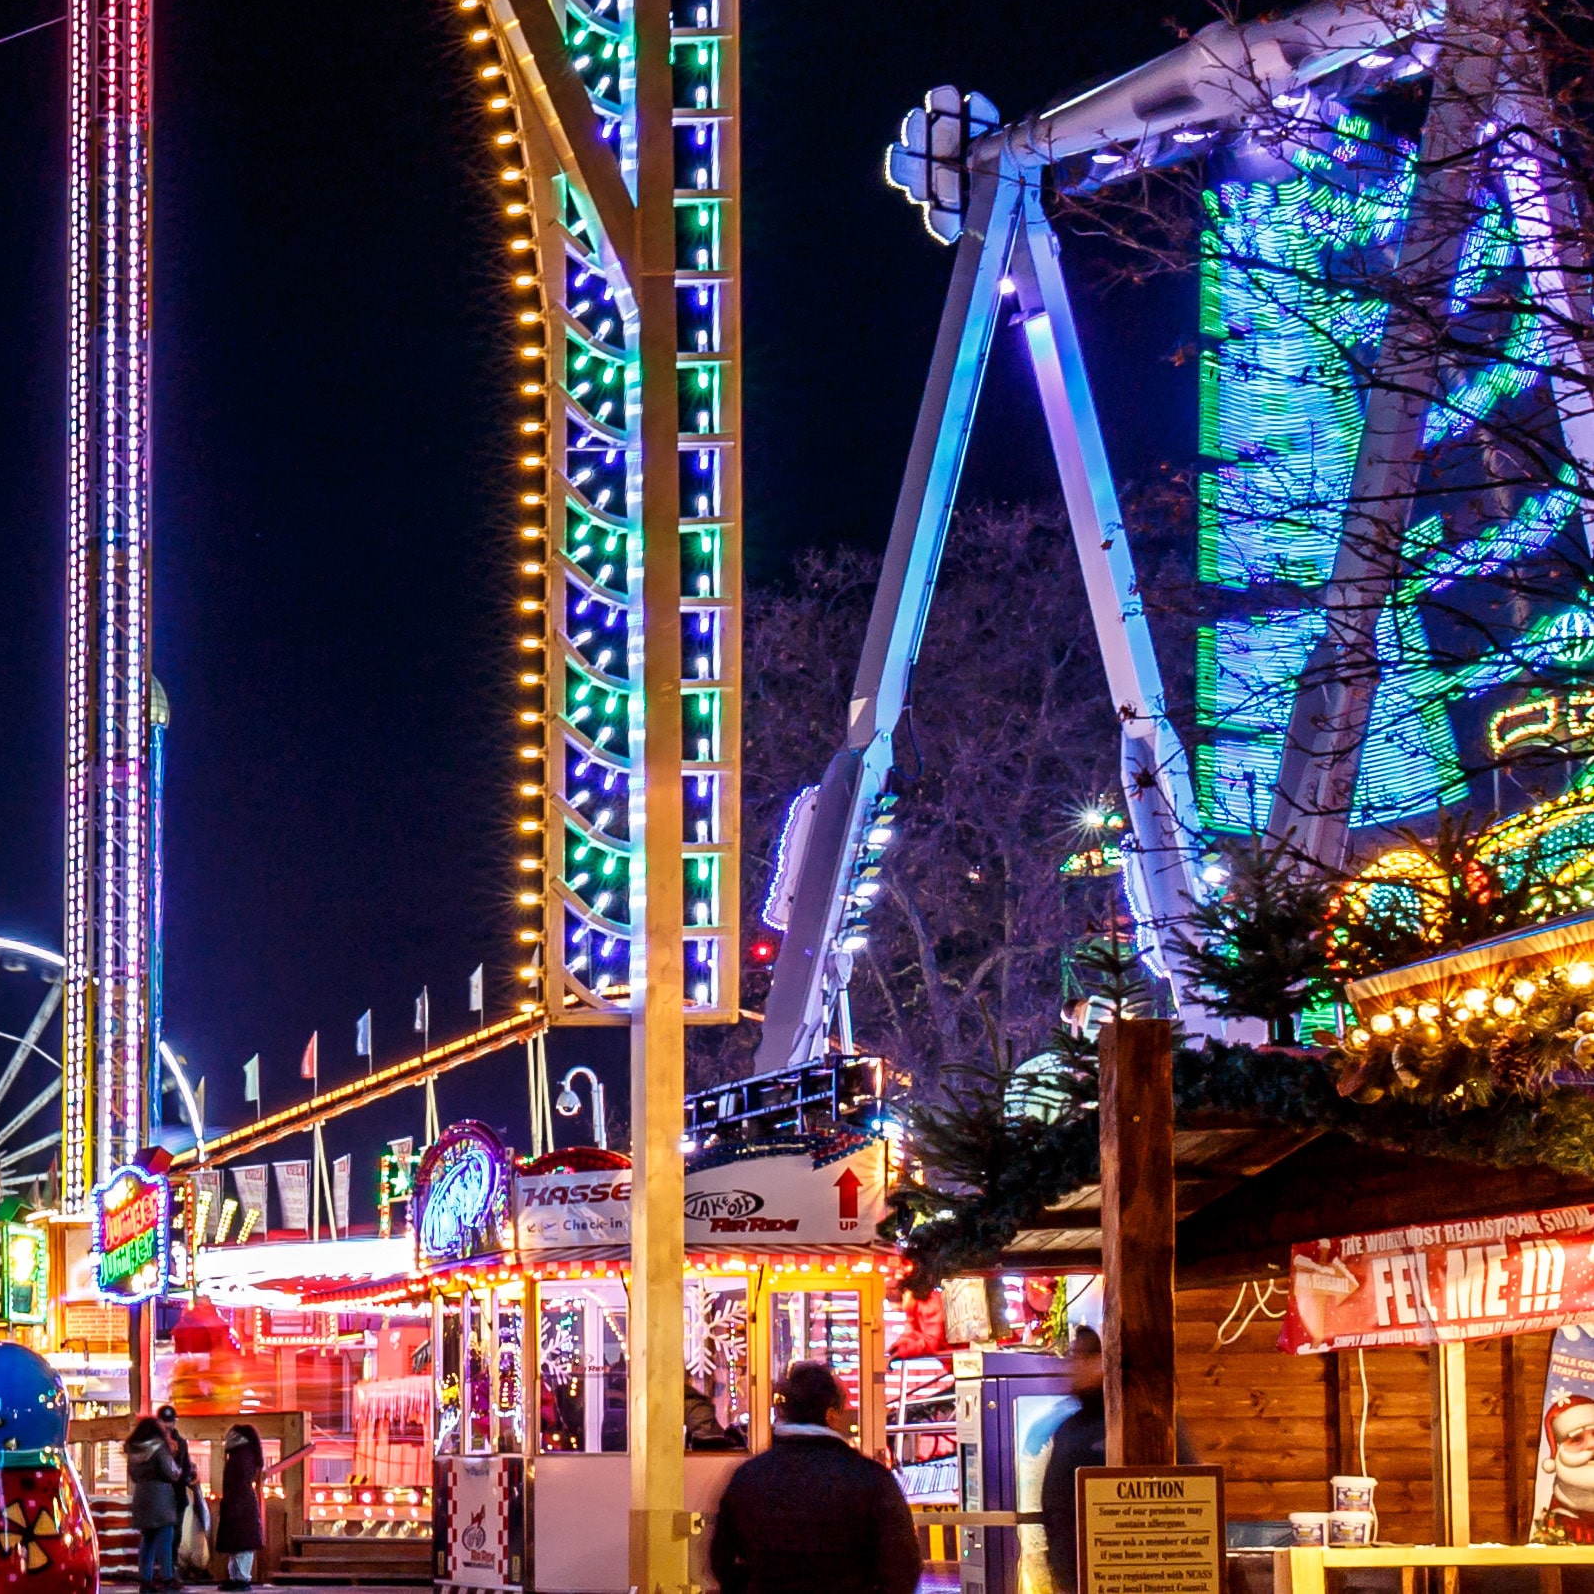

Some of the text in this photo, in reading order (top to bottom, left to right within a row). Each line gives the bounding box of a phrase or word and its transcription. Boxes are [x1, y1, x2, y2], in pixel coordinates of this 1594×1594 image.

[522, 1181, 632, 1207] KASSE
[690, 1194, 730, 1218] TAKE
[563, 1218, 623, 1233] Check-in
[839, 1221, 858, 1231] UP
[1340, 1236, 1364, 1256] THE
[1446, 1243, 1507, 1320] ME
[1518, 1239, 1566, 1313] !!!
[1116, 1481, 1184, 1499] CAUTION
[1098, 1507, 1121, 1516] Some
[1122, 1506, 1132, 1515] of
[1148, 1506, 1185, 1517] products
[1187, 1508, 1203, 1517] may
[1094, 1538, 1120, 1547] Please
[1123, 1537, 1136, 1546] ask
[1146, 1537, 1178, 1546] member
[1180, 1536, 1189, 1545] of
[1191, 1535, 1210, 1545] staff
[1100, 1551, 1107, 1559] if
[1108, 1552, 1123, 1561] you
[1125, 1550, 1143, 1559] have
[1146, 1551, 1159, 1561] any
[1094, 1572, 1106, 1580] We
[1107, 1573, 1121, 1581] are
[1123, 1571, 1164, 1581] registered
[1166, 1571, 1183, 1580] with
[1123, 1584, 1142, 1593] local
[1144, 1584, 1174, 1593] District
